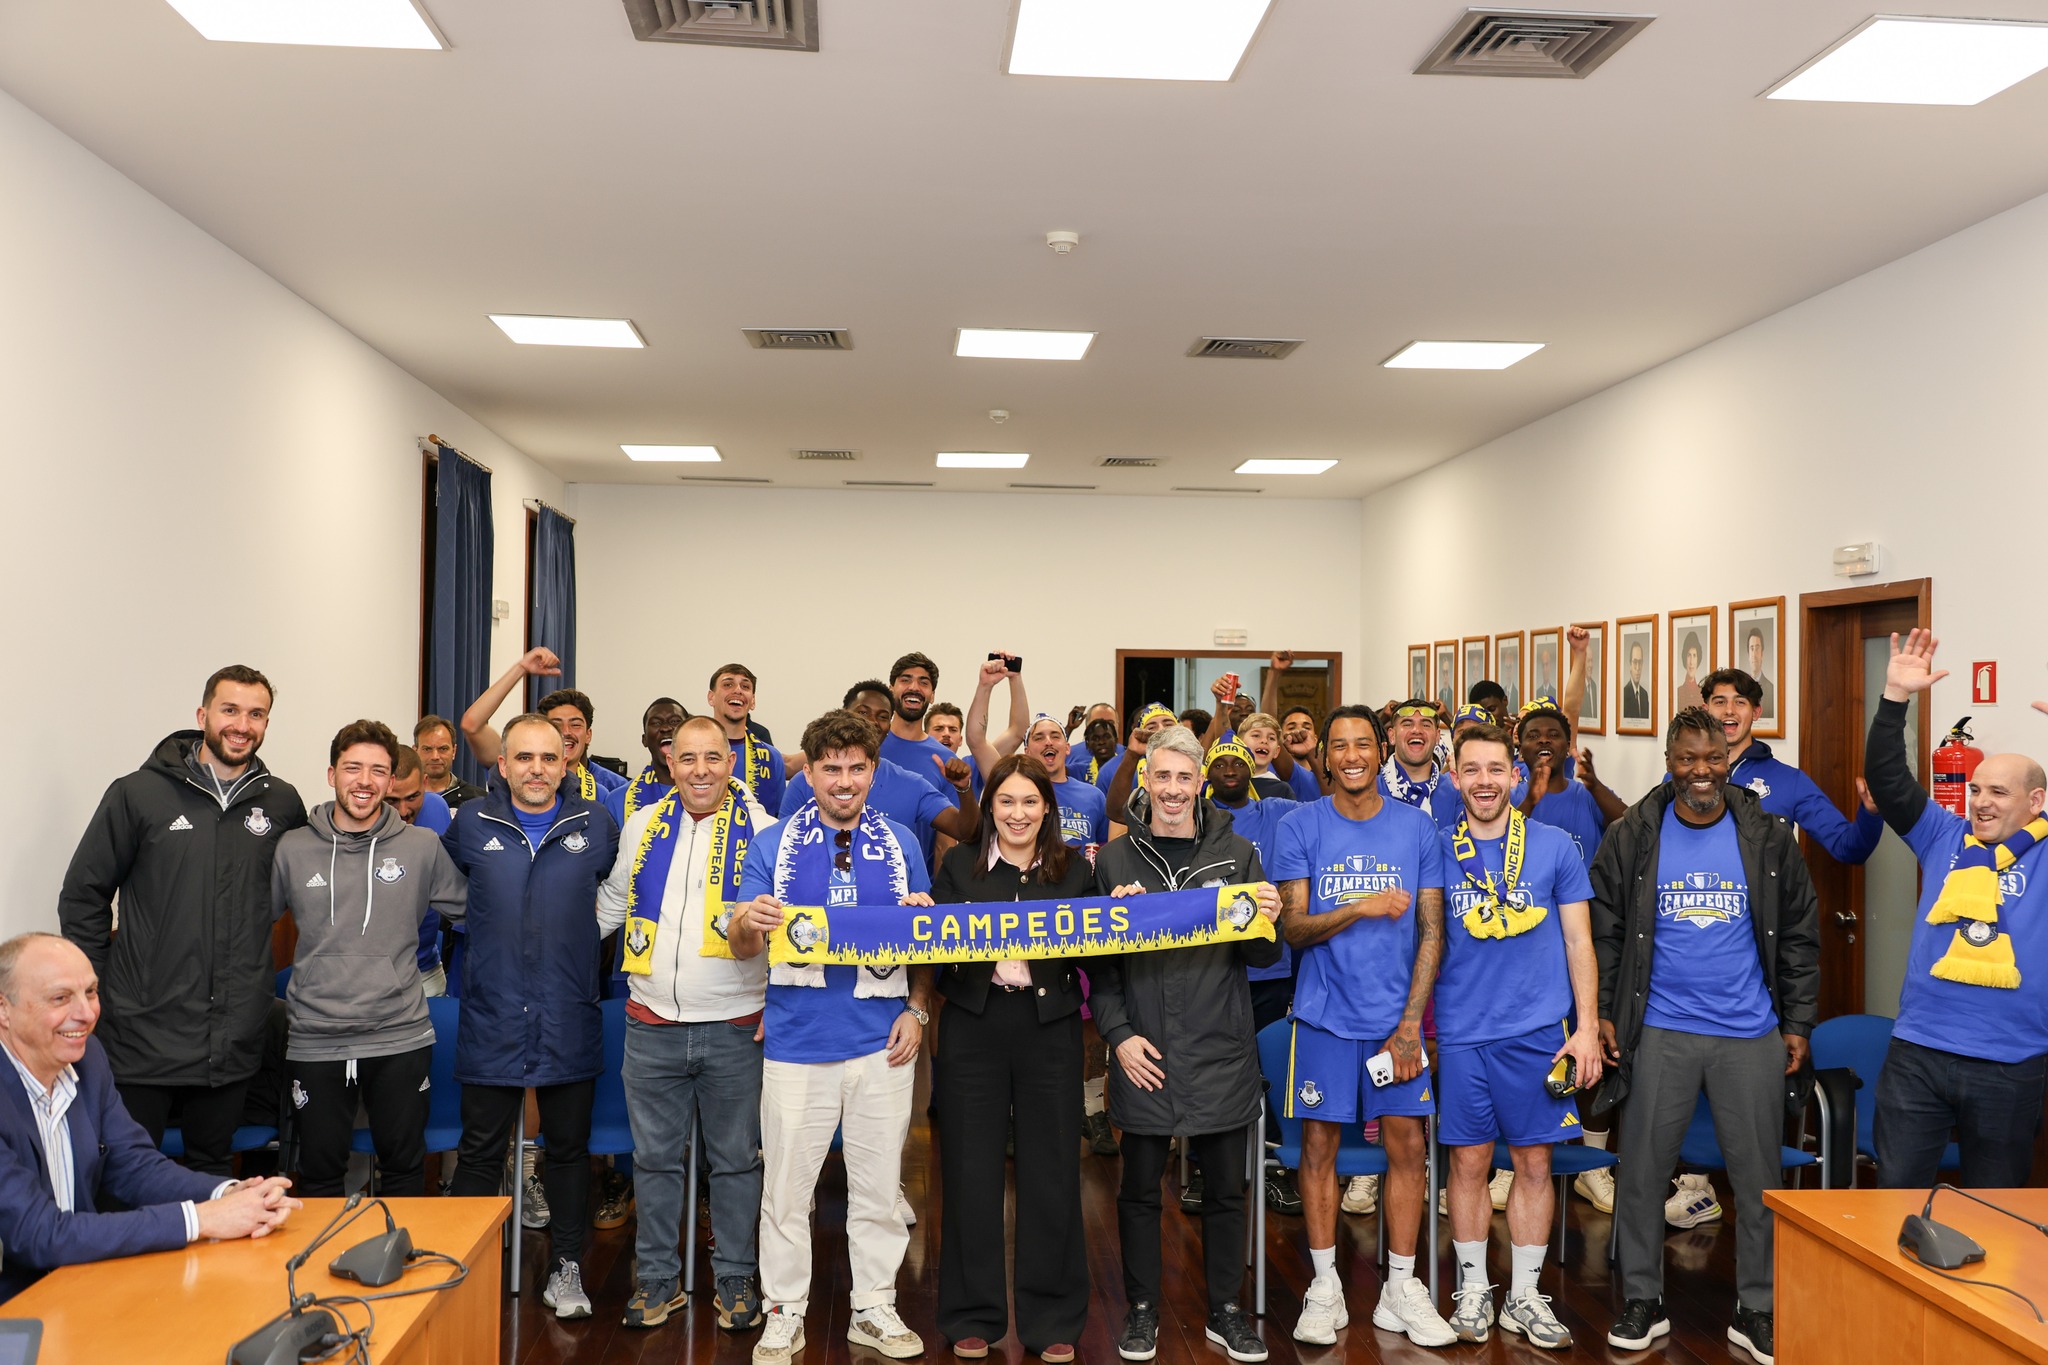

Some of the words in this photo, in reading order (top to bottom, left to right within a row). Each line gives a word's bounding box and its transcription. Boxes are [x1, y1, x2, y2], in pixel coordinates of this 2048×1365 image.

[1215, 744, 1239, 754] UMA
[803, 796, 824, 846] ES
[1060, 818, 1089, 836] PEÕES
[709, 817, 727, 885] CAMPEÃO
[1324, 876, 1397, 896] CAMPEÕES
[826, 888, 858, 906] MP
[1664, 893, 1741, 915] CAMPEÕES
[912, 903, 1130, 941] CAMPEÕES
